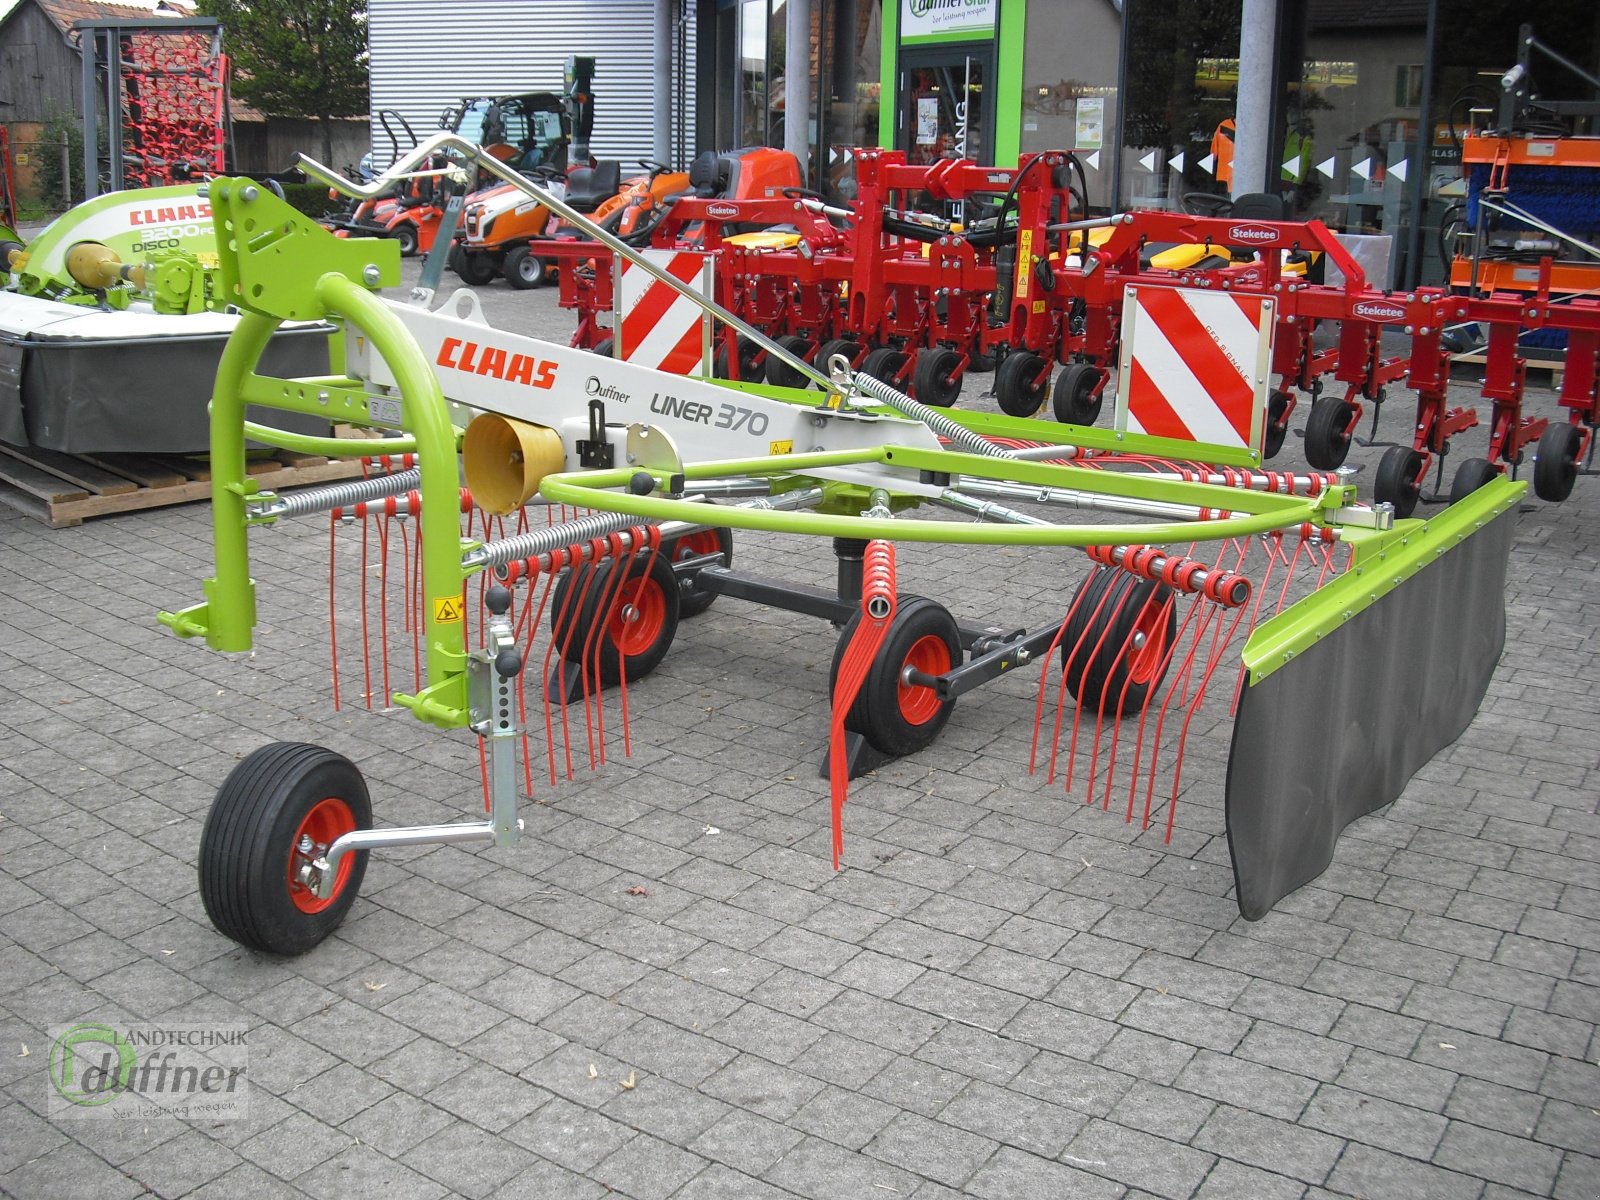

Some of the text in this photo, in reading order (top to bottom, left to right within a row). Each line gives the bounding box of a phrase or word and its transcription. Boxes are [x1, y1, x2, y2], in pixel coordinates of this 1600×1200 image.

[130, 204, 213, 226] CLAAS
[708, 206, 737, 215] Steketee
[1232, 228, 1276, 239] Steketee
[132, 238, 180, 253] DISCO
[1357, 304, 1404, 317] Steketee
[436, 337, 559, 390] CLAAS
[585, 375, 631, 404] Duffner
[650, 392, 770, 437] LINER 370
